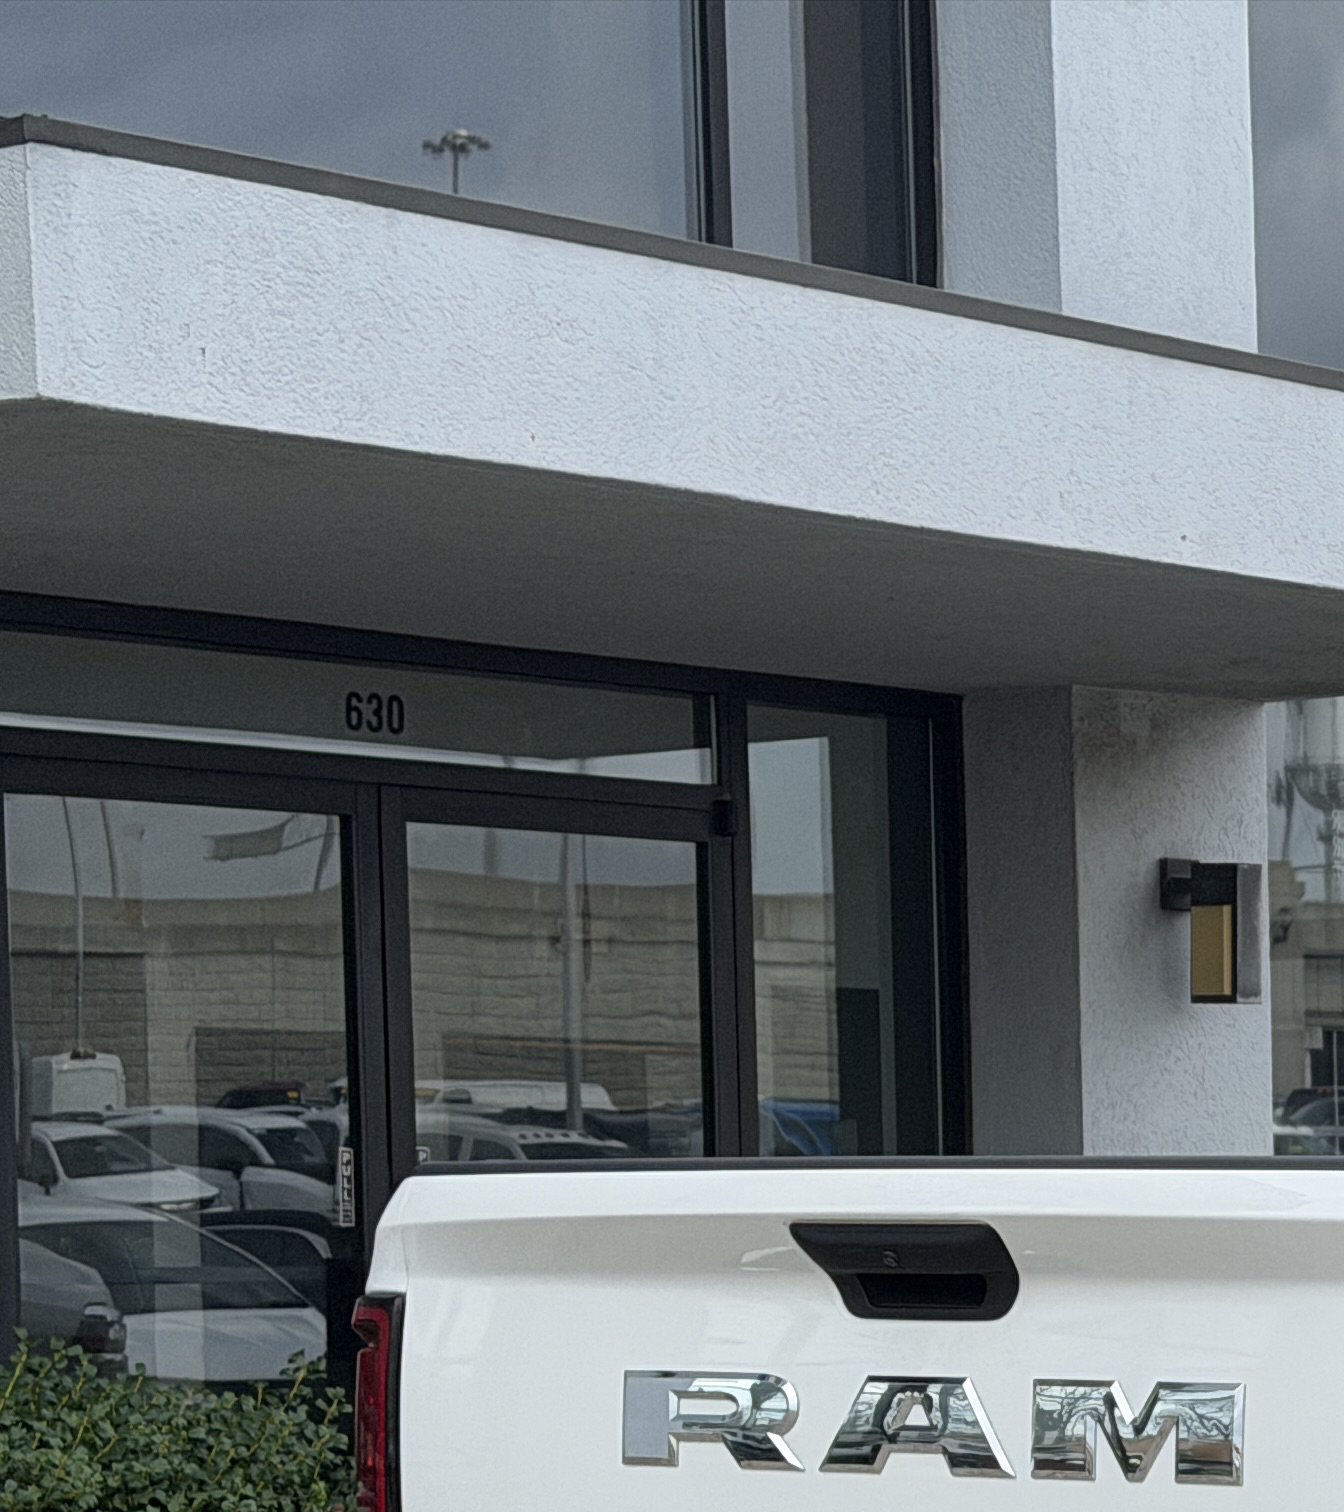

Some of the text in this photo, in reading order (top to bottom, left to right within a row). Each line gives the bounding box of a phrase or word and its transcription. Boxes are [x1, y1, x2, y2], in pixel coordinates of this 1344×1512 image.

[345, 690, 405, 735] 630
[341, 1151, 352, 1201] PULL
[622, 1369, 1247, 1487] RAM
